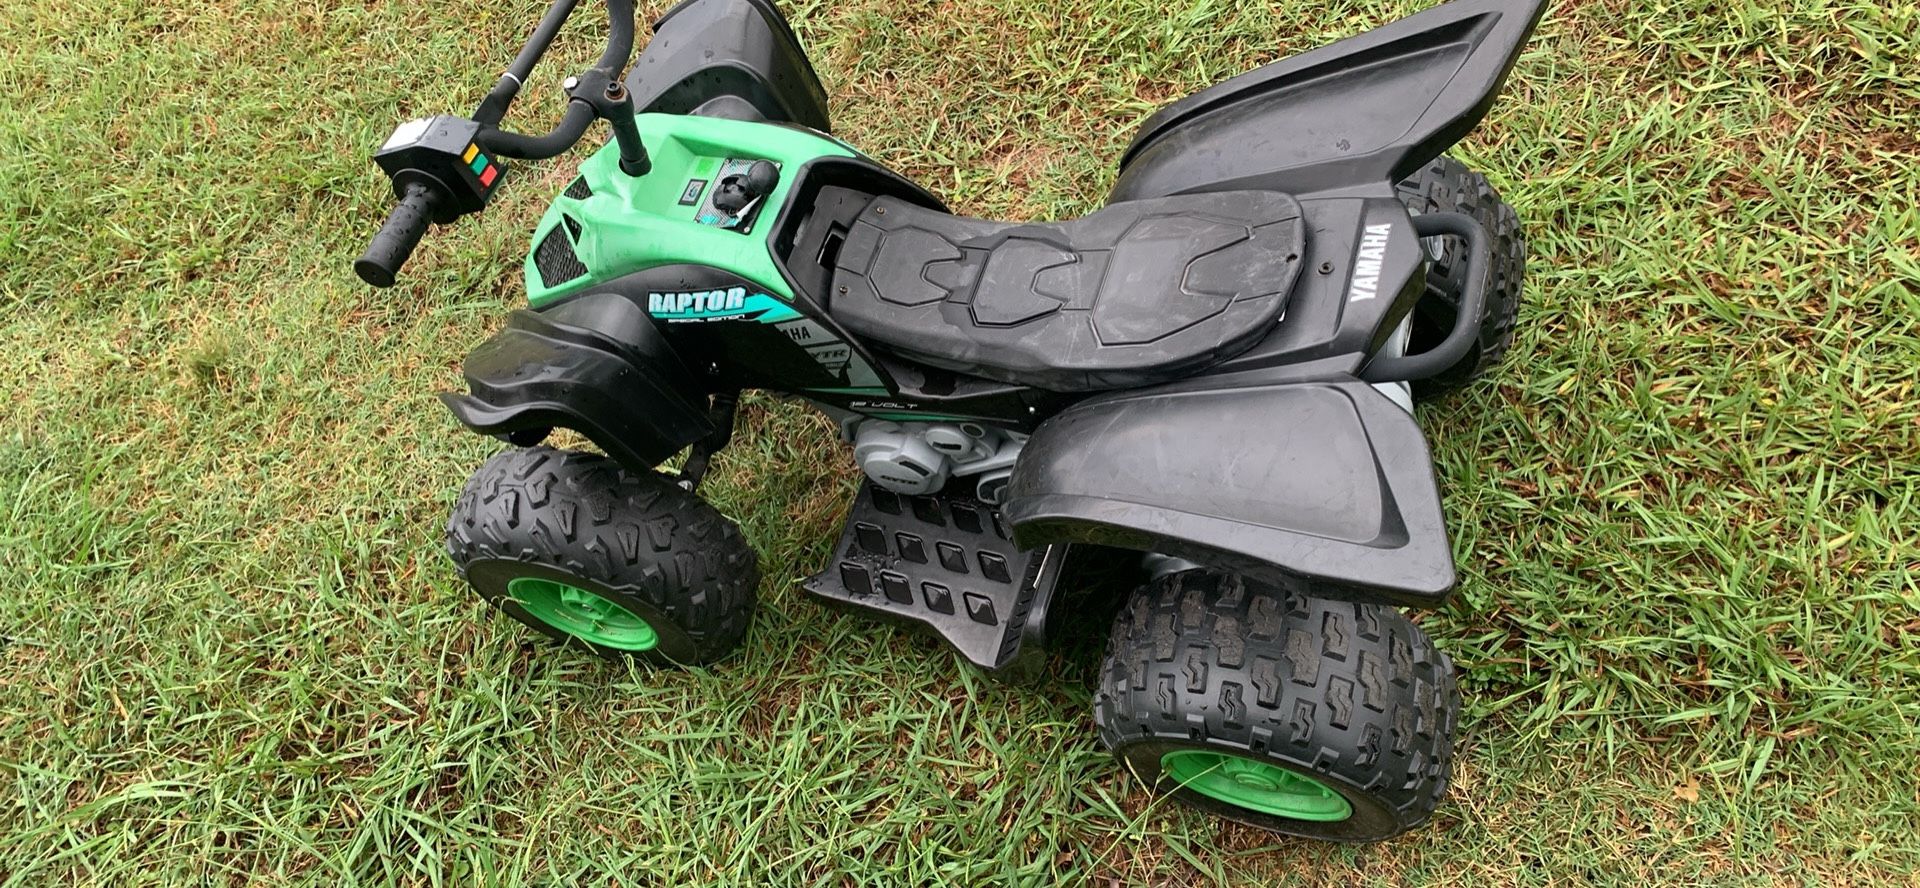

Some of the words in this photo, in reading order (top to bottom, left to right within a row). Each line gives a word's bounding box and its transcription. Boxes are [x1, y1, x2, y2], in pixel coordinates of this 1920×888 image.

[1350, 223, 1391, 302] YAMAHA
[648, 287, 746, 313] RAPTOR
[871, 401, 918, 409] VOLT
